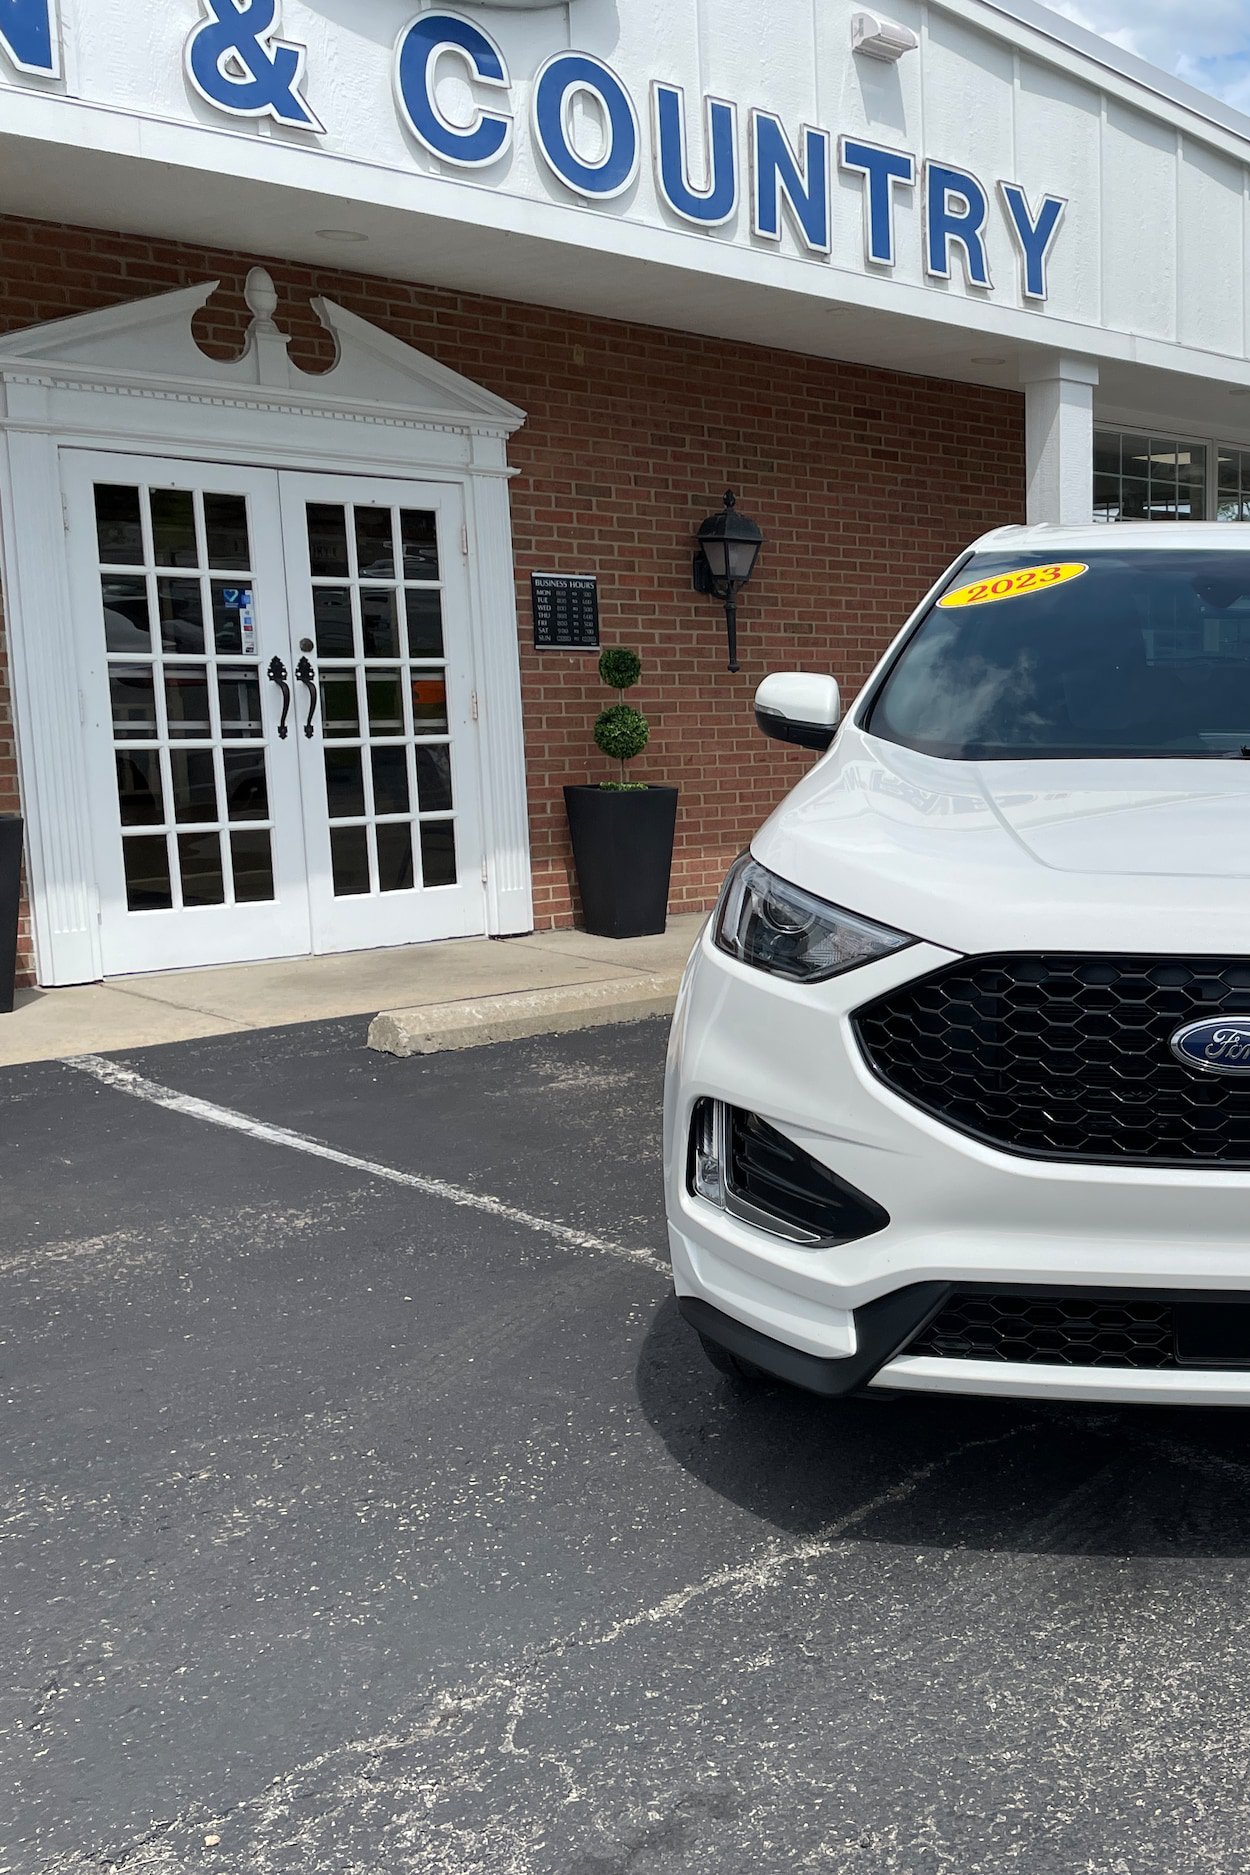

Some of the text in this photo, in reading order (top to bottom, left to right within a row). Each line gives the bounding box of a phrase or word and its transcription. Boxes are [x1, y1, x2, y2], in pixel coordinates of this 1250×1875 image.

[183, 0, 1069, 302] & COUNTRY
[535, 579, 595, 590] BUSINESS HOURS
[967, 566, 1062, 603] 2023
